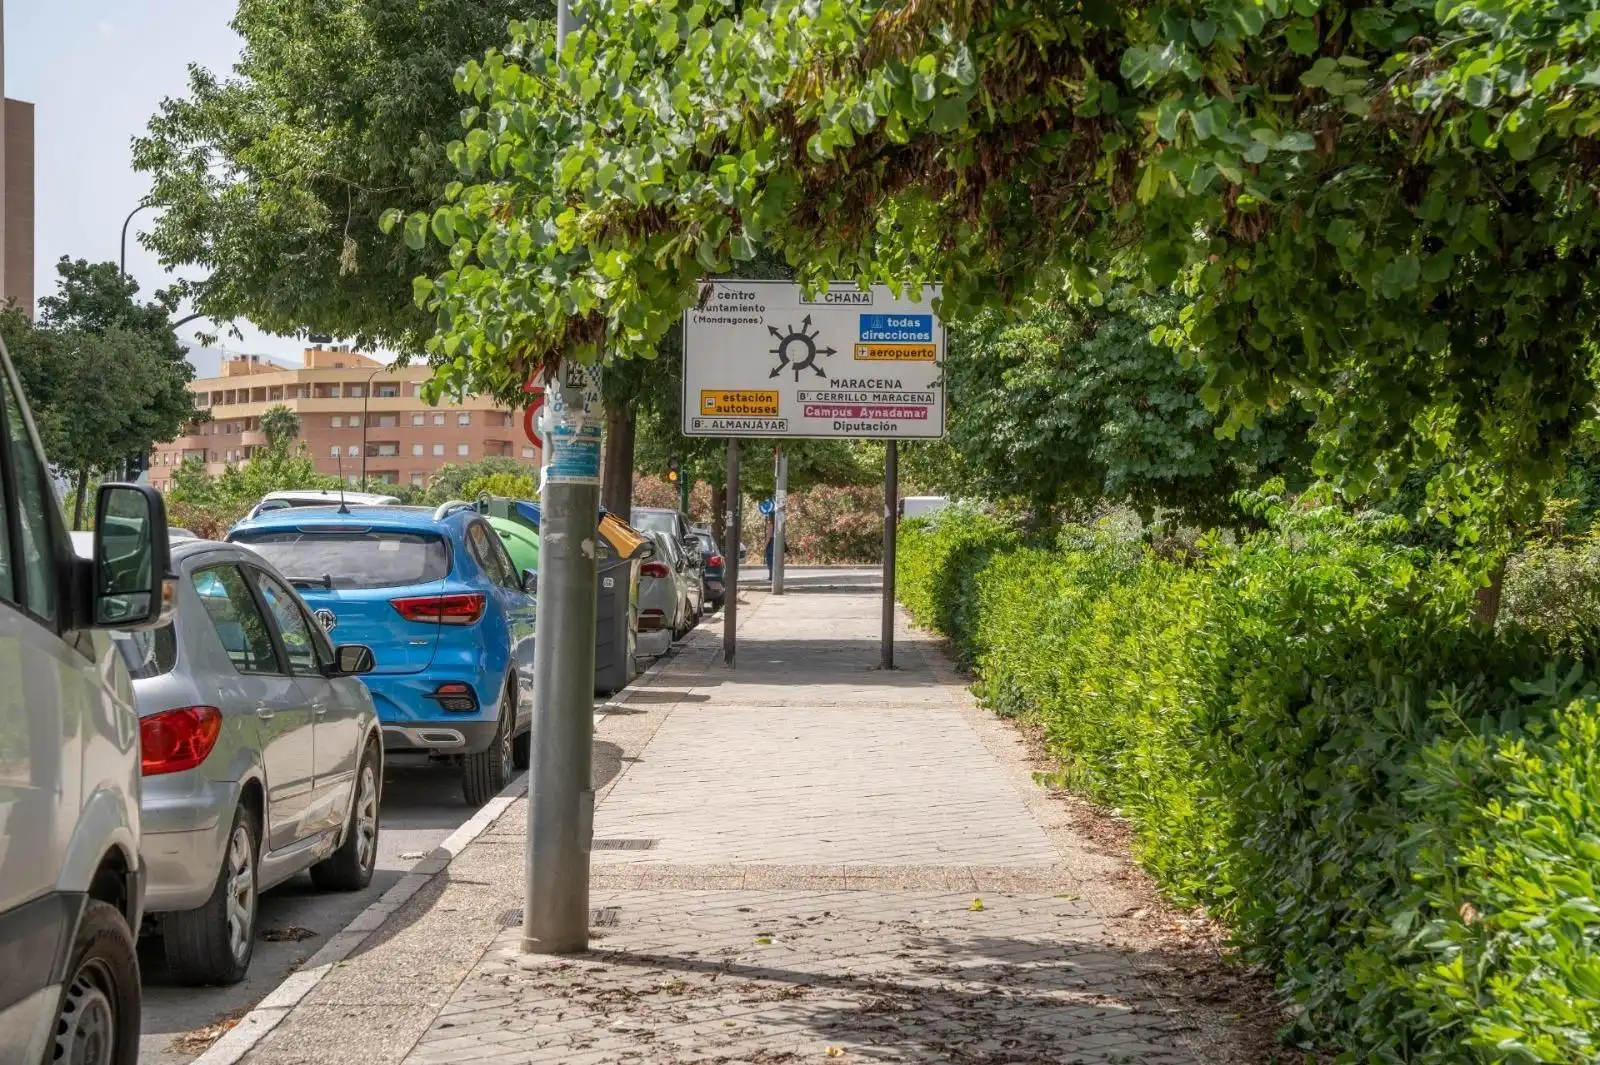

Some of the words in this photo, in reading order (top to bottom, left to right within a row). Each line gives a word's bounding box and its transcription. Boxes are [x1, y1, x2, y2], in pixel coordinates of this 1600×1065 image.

[717, 290, 756, 300] centro
[824, 291, 871, 303] CHANA
[693, 315, 764, 325] (Mondragones)
[887, 317, 921, 328] todas
[861, 329, 930, 340] direcciones
[869, 346, 934, 359] aeropuerto
[830, 379, 903, 389] MARACENA
[722, 392, 773, 403] estación
[816, 392, 868, 402] CERRILLO
[872, 393, 932, 403] MARACENA
[716, 404, 777, 414] autobuses
[805, 405, 853, 418] Campus
[859, 407, 926, 419] Aynadamar
[833, 420, 898, 432] Diputación
